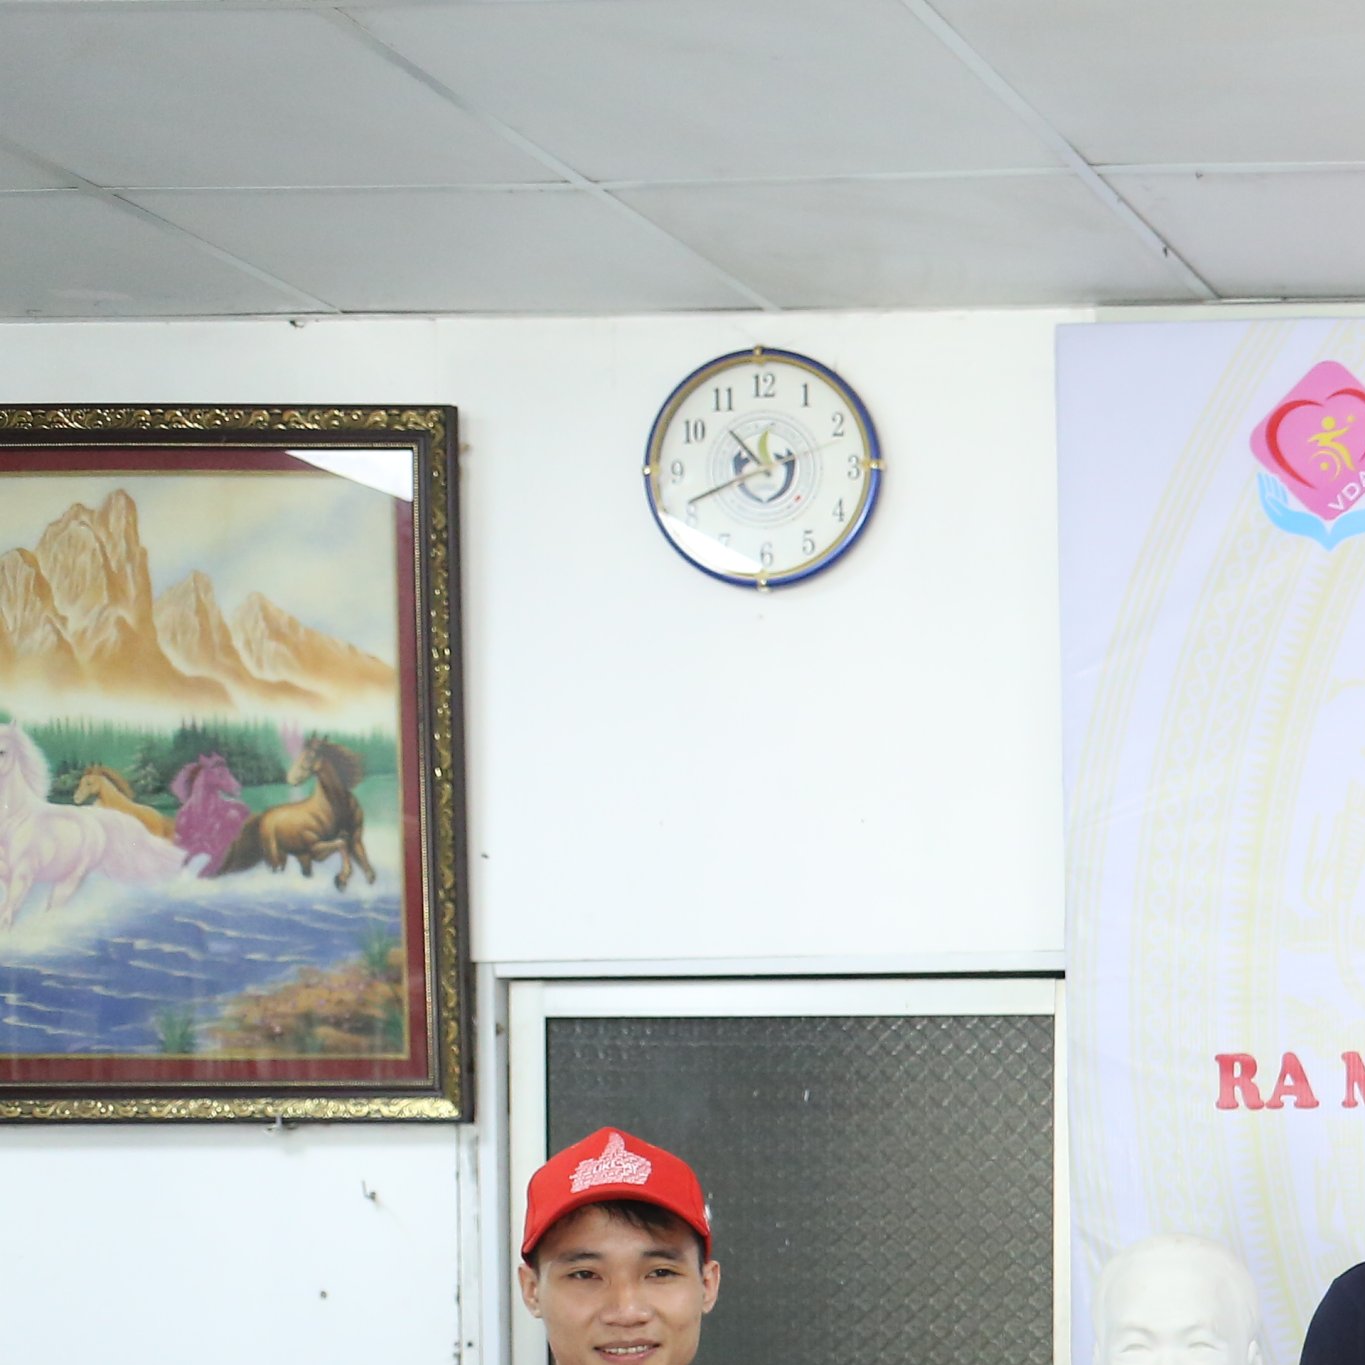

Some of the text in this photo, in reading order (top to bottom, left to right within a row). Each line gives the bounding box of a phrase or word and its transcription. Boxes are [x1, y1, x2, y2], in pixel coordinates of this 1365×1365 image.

[752, 374, 776, 398] 12
[801, 384, 810, 408] 1
[713, 388, 734, 412] 11
[683, 419, 705, 444] 10
[832, 412, 844, 438] 2
[671, 460, 684, 484] 9
[848, 456, 860, 480] 3
[832, 499, 844, 522] 4
[802, 530, 815, 554] 5
[760, 542, 773, 567] 6
[1215, 1051, 1321, 1111] RA
